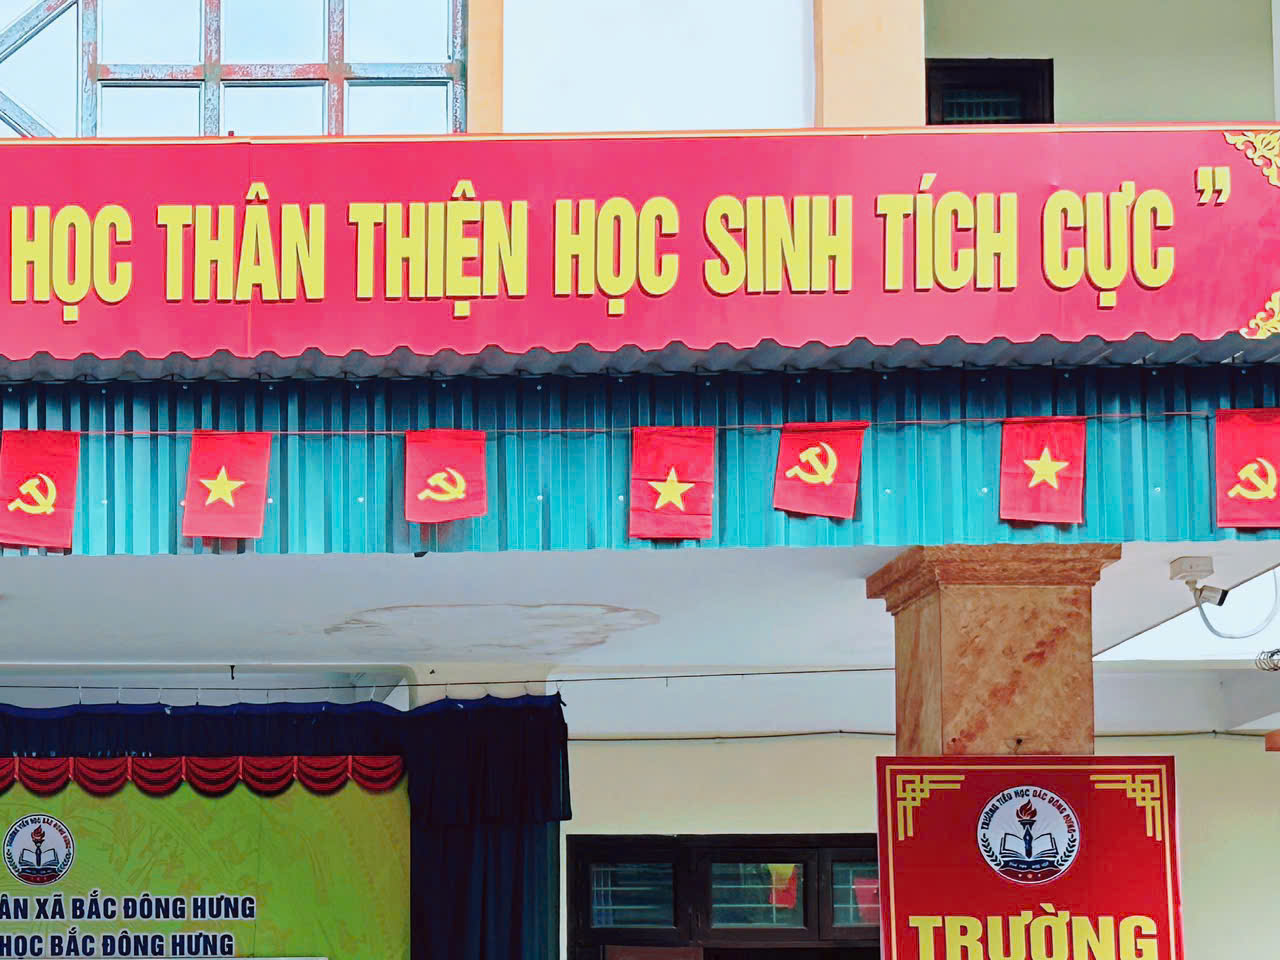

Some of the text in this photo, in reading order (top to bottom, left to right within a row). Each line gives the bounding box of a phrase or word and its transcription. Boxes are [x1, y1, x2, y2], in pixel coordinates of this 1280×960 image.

[11, 205, 133, 321] HỌC
[157, 182, 326, 302] THÂN
[348, 180, 529, 317] THIỆN
[554, 196, 680, 315] HỌC
[704, 195, 854, 295] SINH
[877, 174, 1018, 290] TÍCH
[35, 893, 65, 920] XÃ
[71, 890, 117, 919] BẮC
[123, 893, 186, 919] ĐÔNG
[192, 894, 255, 919] HƯNG
[50, 926, 95, 956] BẮC
[102, 930, 165, 956] ĐÔNG
[171, 932, 234, 956] HƯNG
